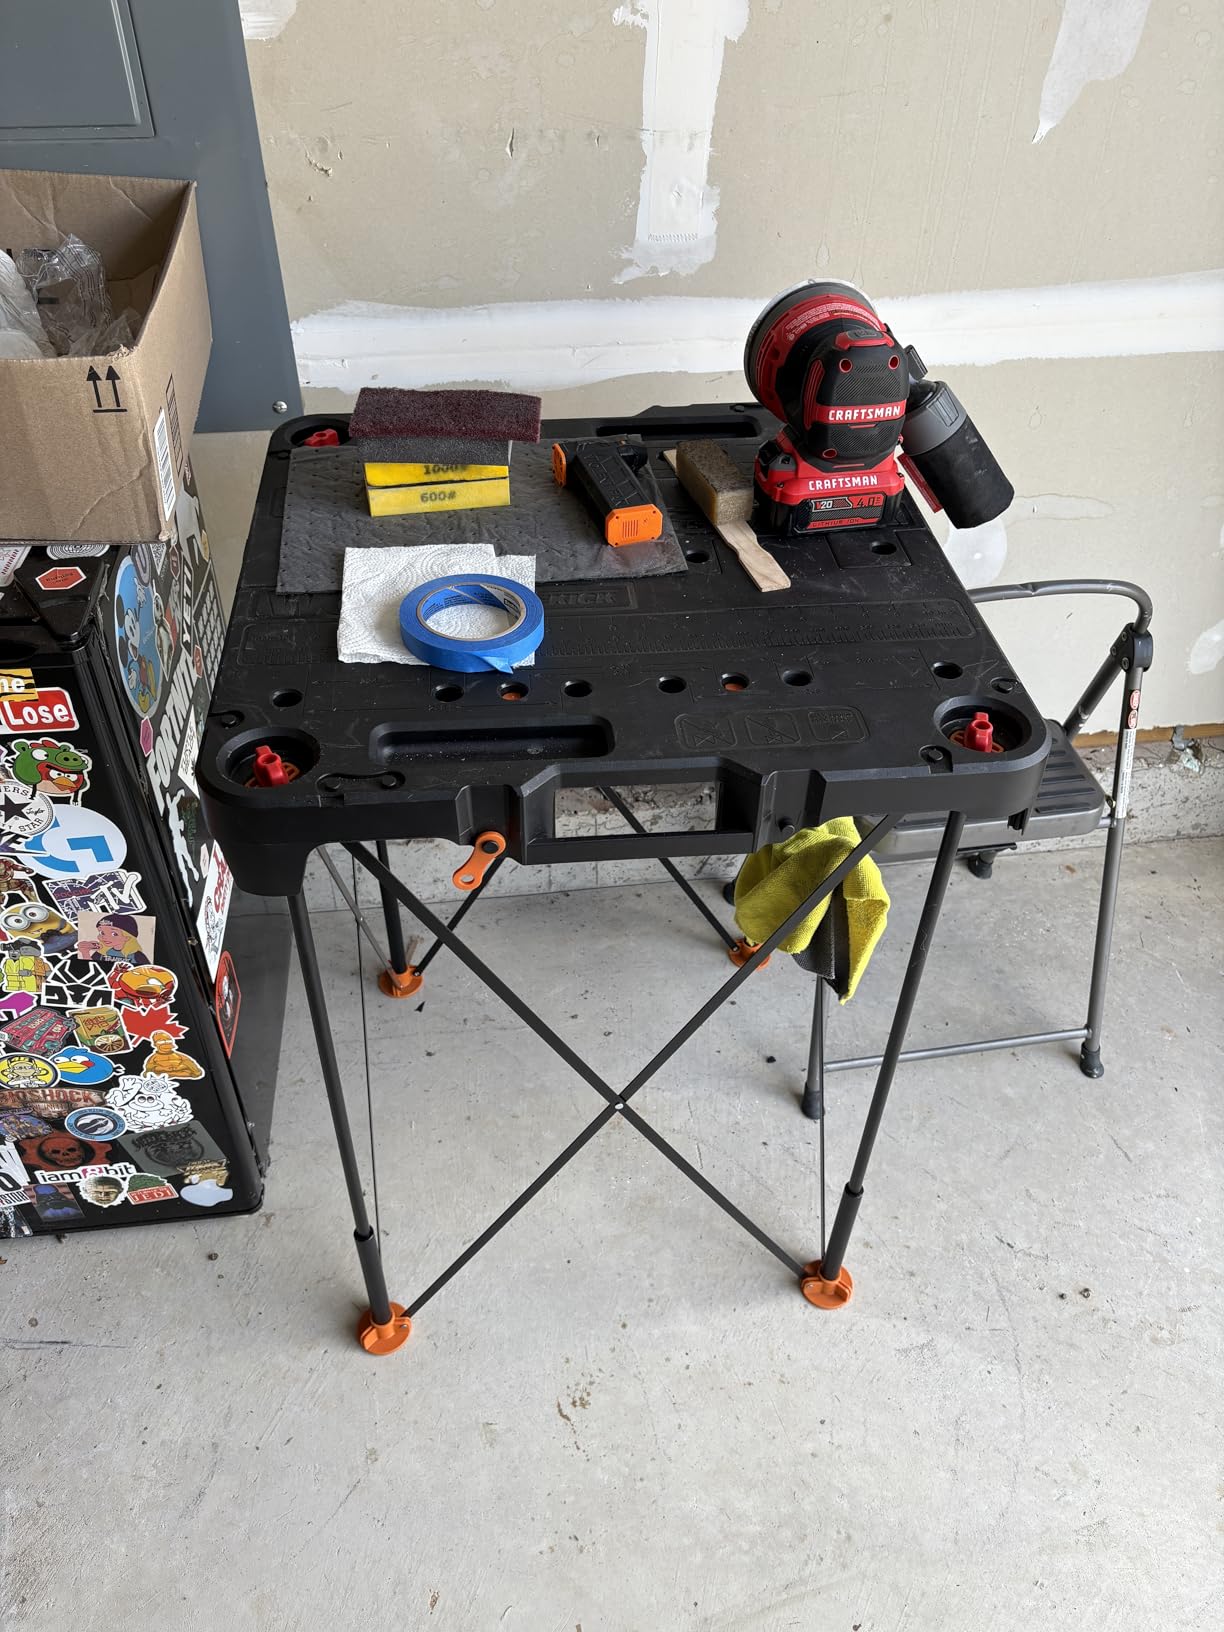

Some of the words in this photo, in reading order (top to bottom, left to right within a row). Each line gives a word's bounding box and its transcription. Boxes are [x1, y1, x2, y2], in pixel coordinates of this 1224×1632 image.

[828, 405, 901, 421] CRAFTSMAN
[808, 475, 878, 491] CRAFTSMAN
[420, 490, 457, 503] 600#
[857, 497, 875, 507] 4.0
[182, 564, 193, 643] YETI
[2, 700, 70, 726] Lose
[18, 817, 44, 833] STAR
[132, 1188, 173, 1202] JEDI
